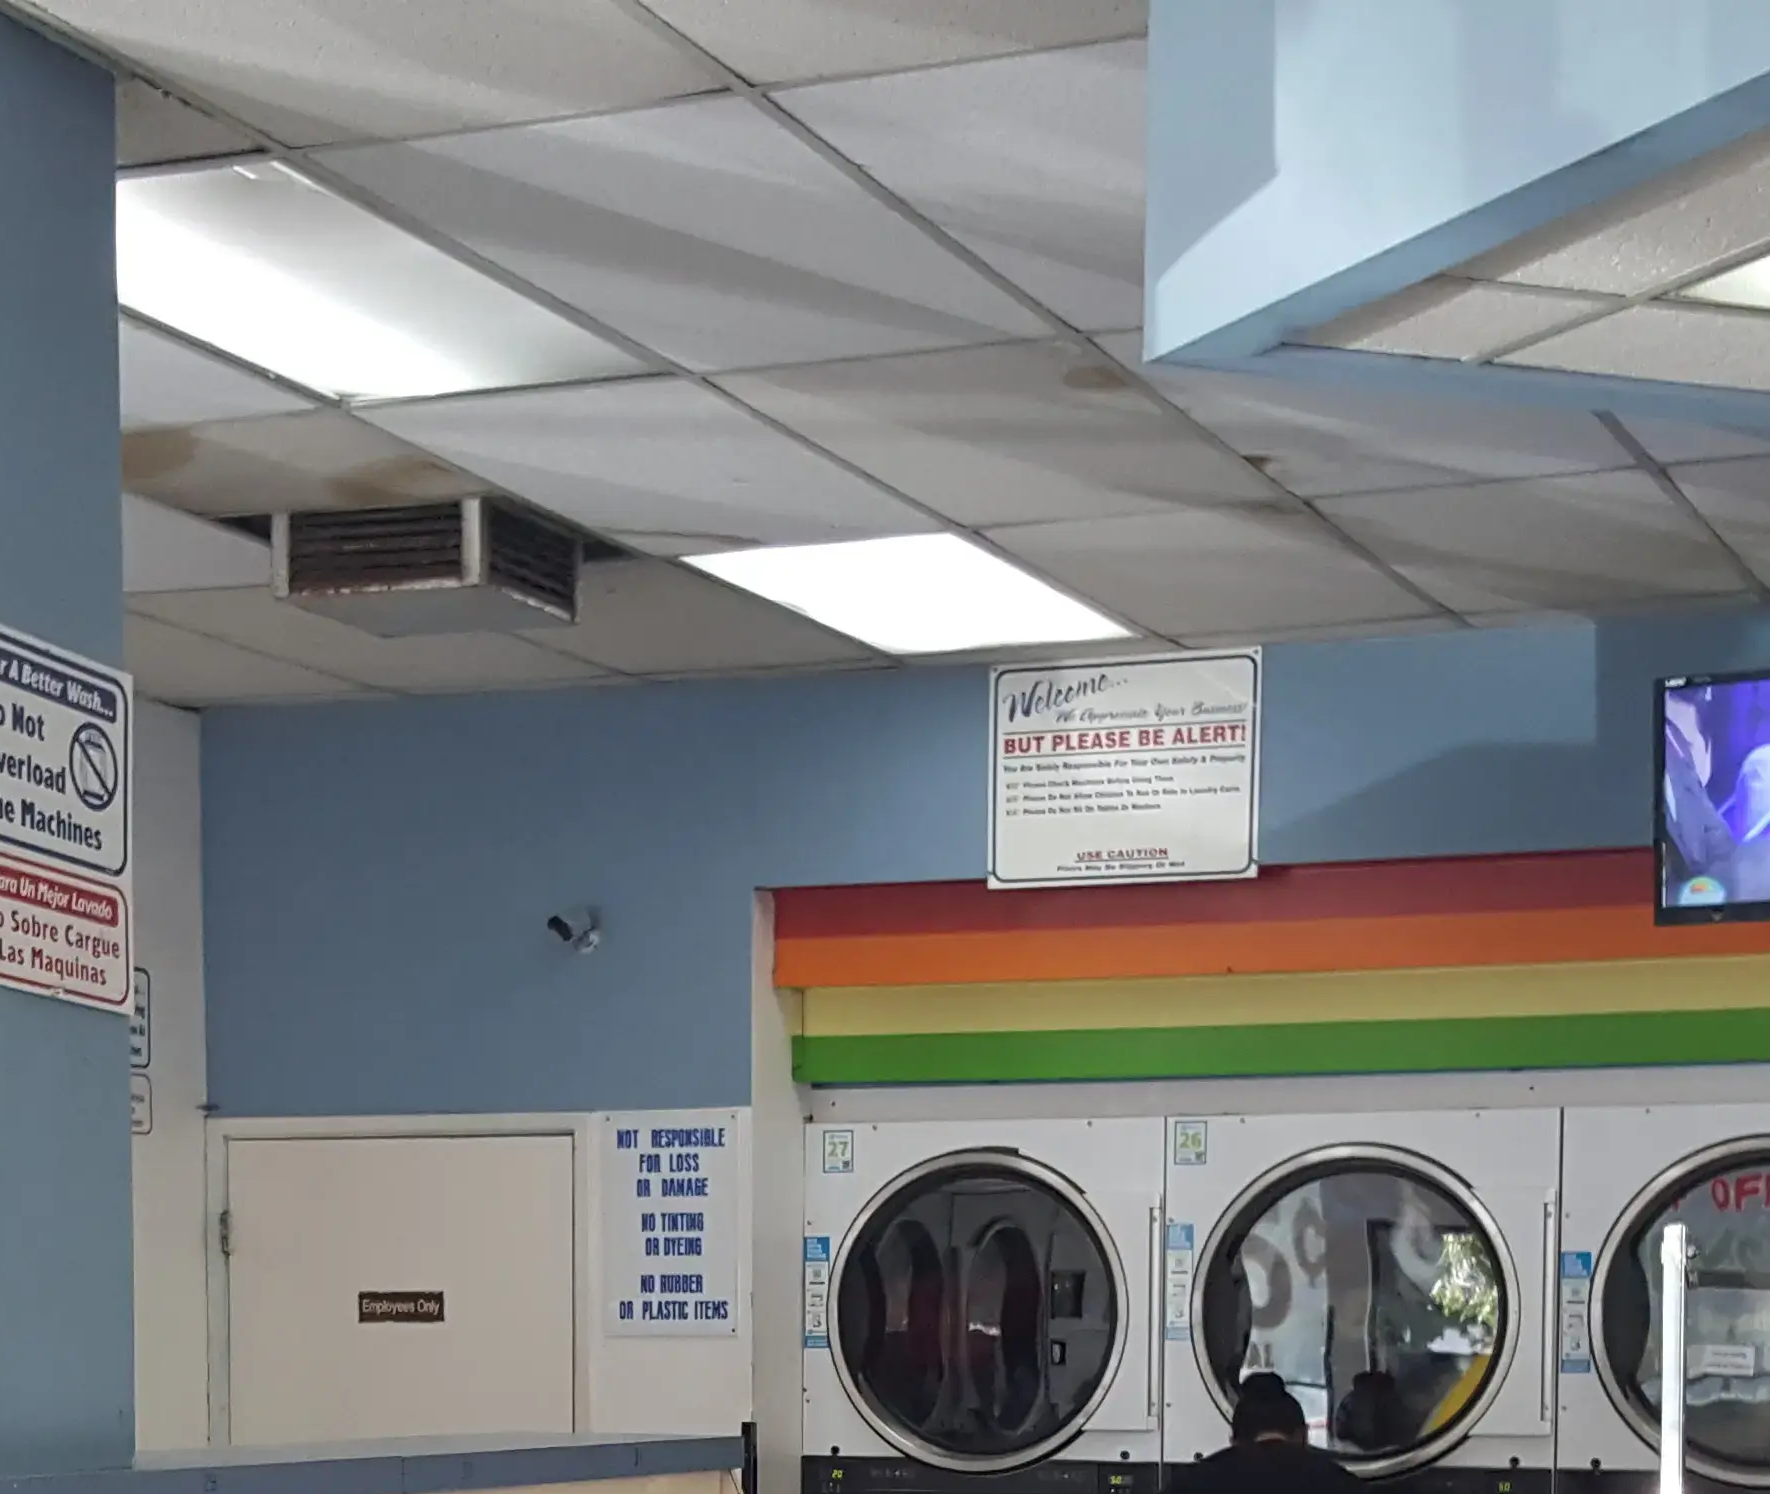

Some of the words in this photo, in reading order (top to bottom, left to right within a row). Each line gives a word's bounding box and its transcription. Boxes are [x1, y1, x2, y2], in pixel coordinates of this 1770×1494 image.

[9, 660, 19, 681] A
[21, 664, 65, 697] Better
[67, 680, 113, 717] Wash...
[11, 702, 46, 742] Not
[1003, 735, 1045, 755] BUT
[1052, 730, 1131, 752] PLEASE
[1138, 728, 1164, 746] BE
[1171, 724, 1247, 746] ALERT!
[21, 798, 102, 851] Machines
[1076, 850, 1102, 860] USE
[1107, 847, 1168, 859] CAUTION
[19, 876, 36, 899] Un
[37, 882, 70, 909] Mejor
[72, 891, 113, 920] Lavado
[11, 910, 59, 943] Sobre
[65, 924, 121, 960] Cargue
[31, 946, 107, 986] Maquinas
[616, 1128, 639, 1149] NOT
[650, 1127, 726, 1148] RESPONSIBLE
[1178, 1132, 1202, 1149] 26
[827, 1141, 850, 1157] 27
[639, 1153, 661, 1173] FOR
[669, 1153, 699, 1173] LOSS
[636, 1178, 651, 1198] OR
[662, 1177, 709, 1198] DAMAGE
[641, 1212, 656, 1232] NO
[661, 1212, 704, 1232] TINTING
[645, 1237, 659, 1256] OR
[663, 1237, 702, 1256] DYEING
[640, 1274, 655, 1294] NO
[660, 1274, 703, 1294] RUBBER
[362, 1299, 415, 1315] Employees
[417, 1299, 440, 1316] Only
[619, 1301, 634, 1321] OR
[642, 1301, 689, 1321] PLASTIC
[694, 1300, 729, 1320] ITEMS
